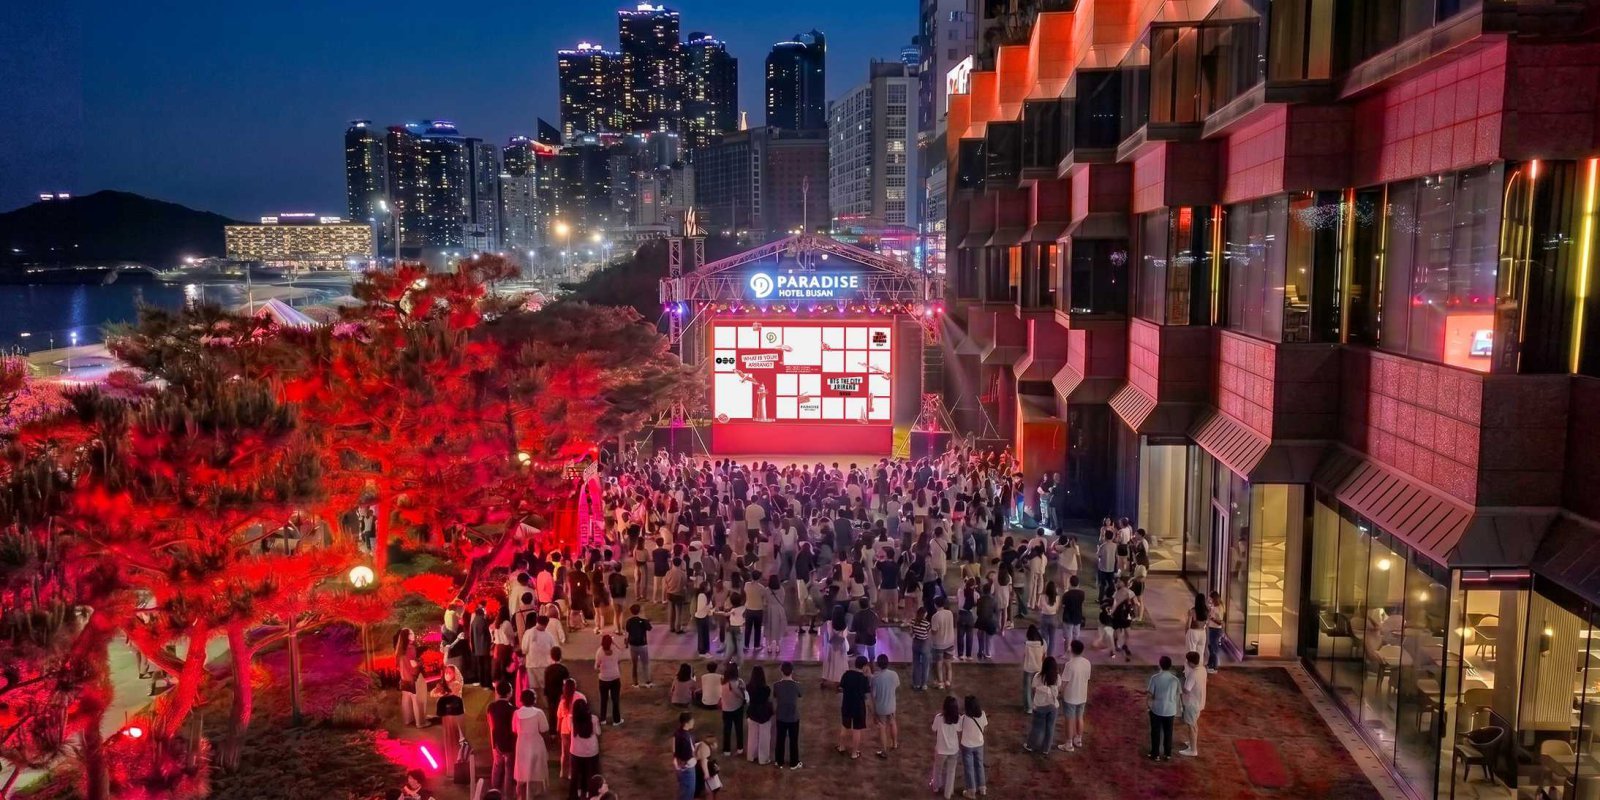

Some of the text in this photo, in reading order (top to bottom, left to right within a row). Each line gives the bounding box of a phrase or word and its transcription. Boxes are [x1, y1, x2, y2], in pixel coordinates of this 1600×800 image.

[777, 275, 858, 288] PARADISE
[779, 289, 833, 297] HOTEL BUSAN
